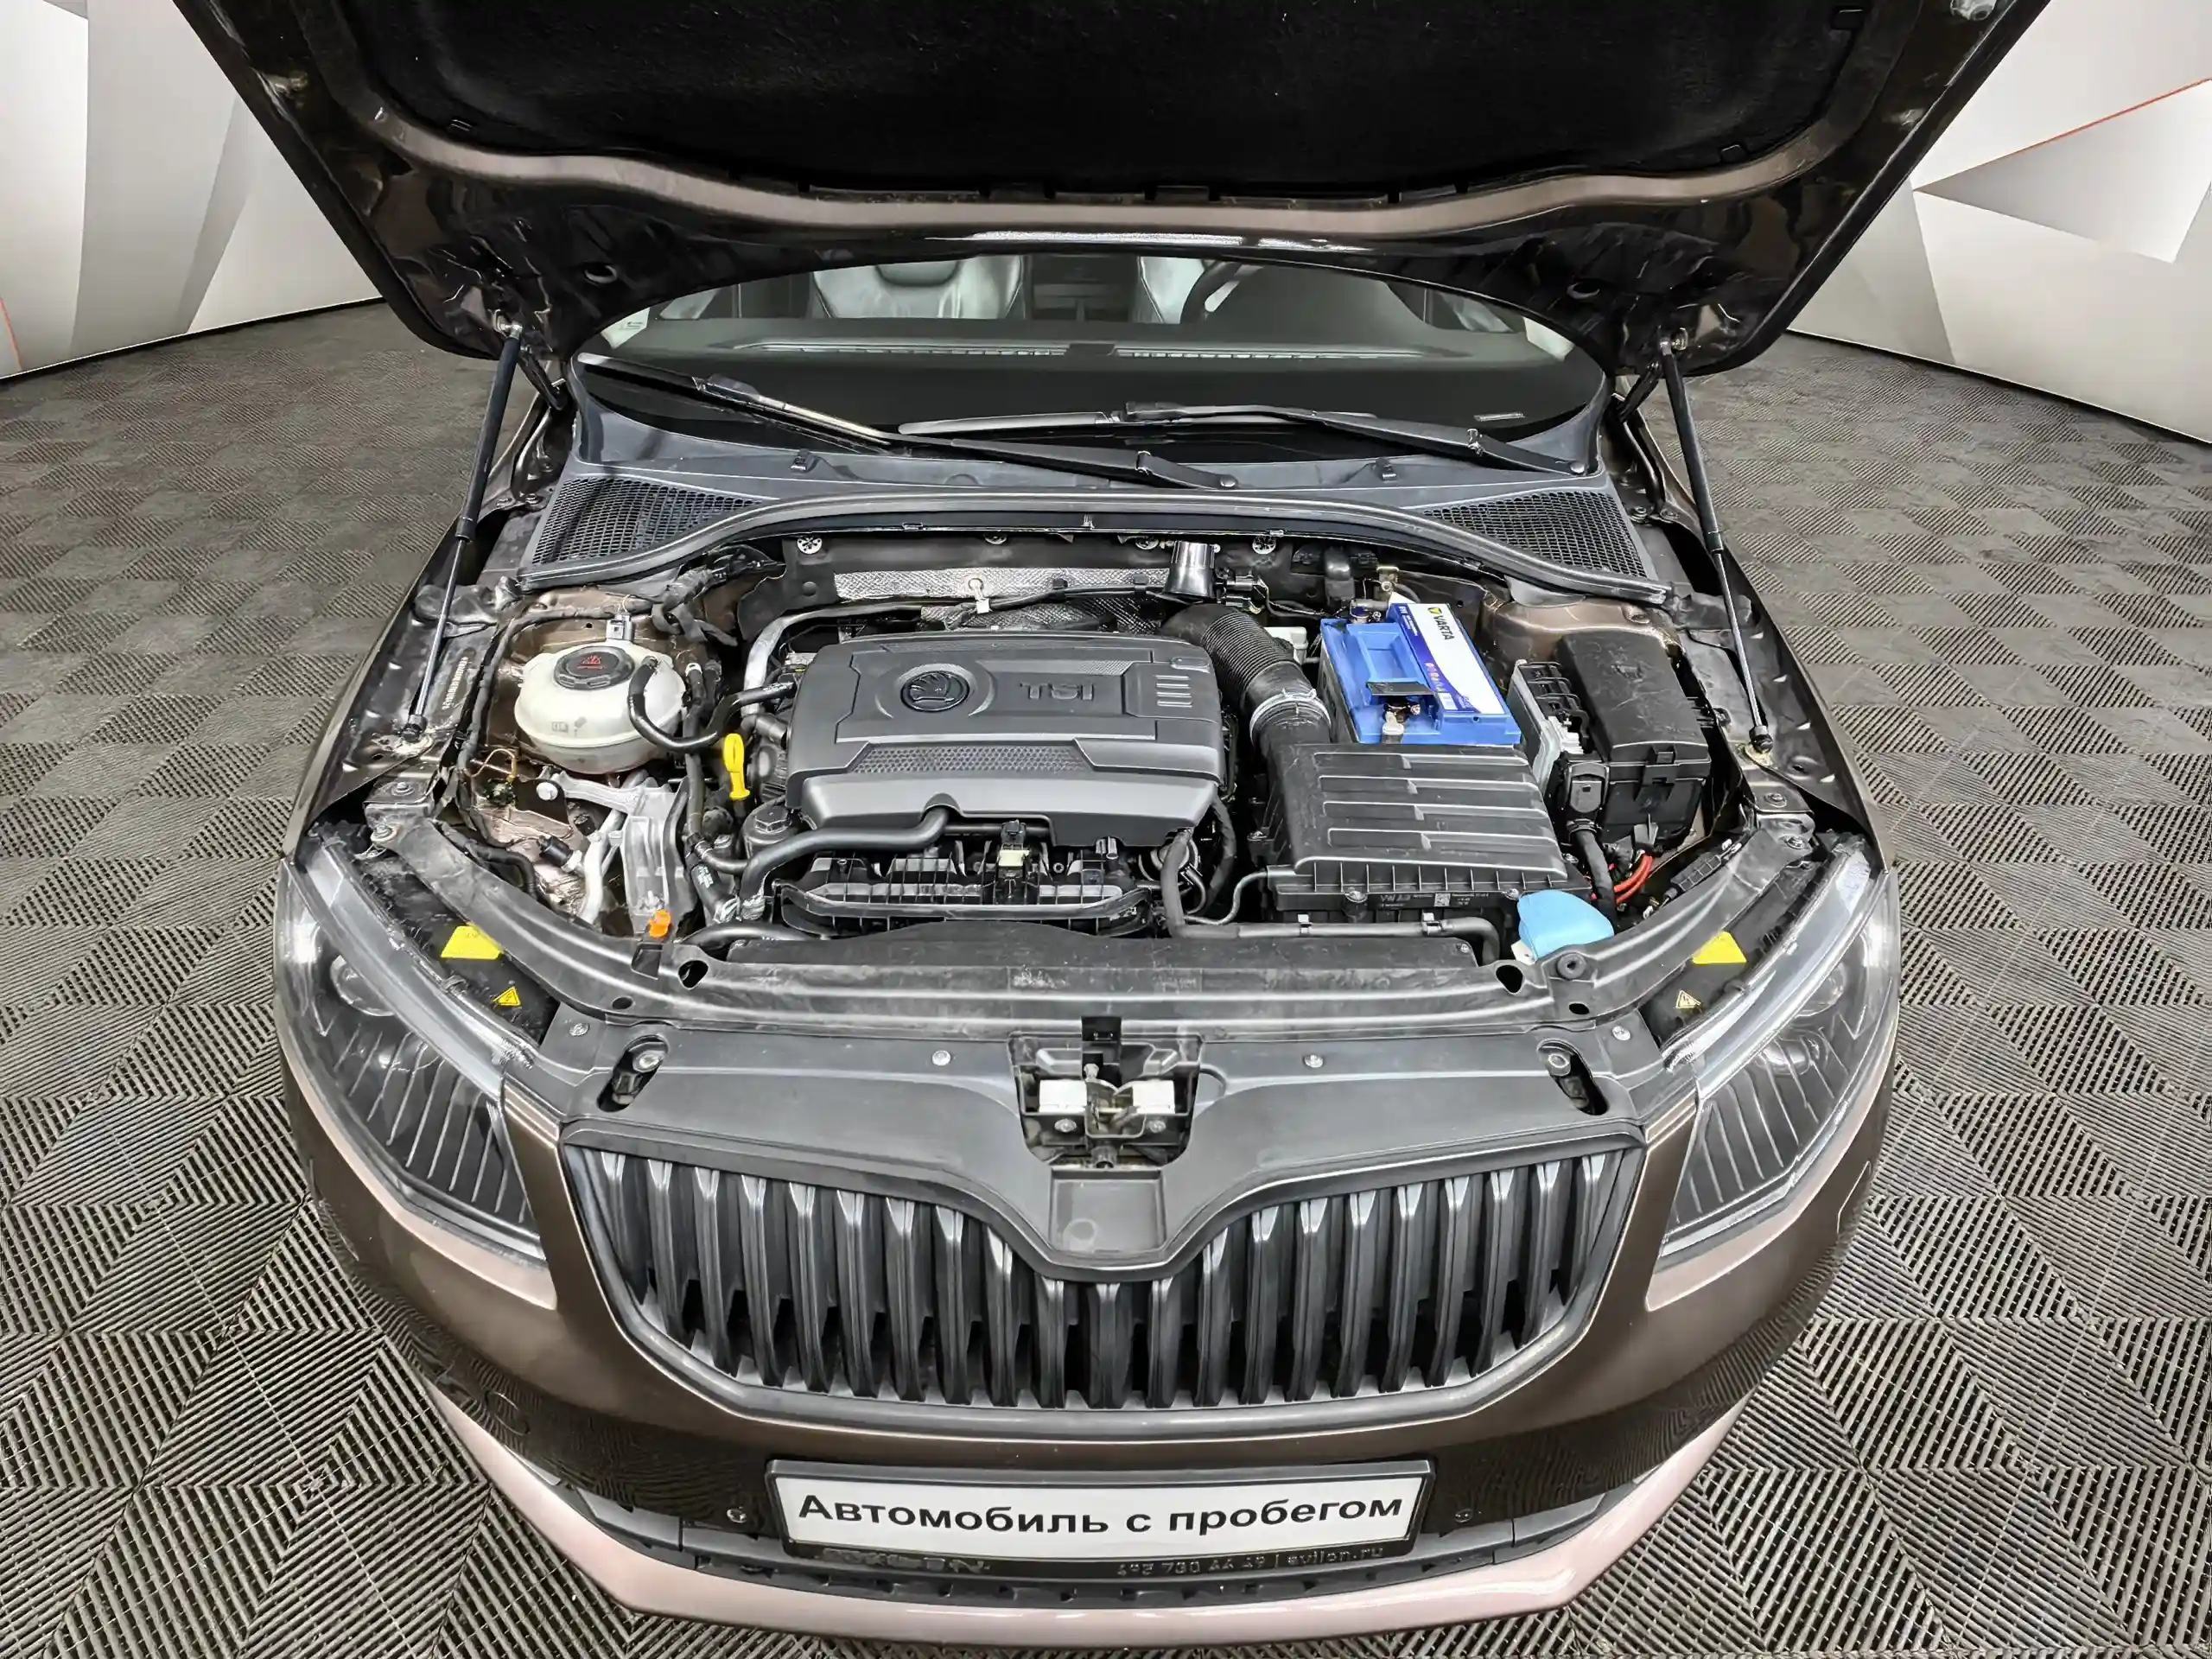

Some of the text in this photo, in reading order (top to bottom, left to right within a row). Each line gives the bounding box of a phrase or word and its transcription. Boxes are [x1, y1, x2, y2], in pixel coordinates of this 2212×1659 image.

[1433, 615, 1454, 640] VARTA
[1019, 681, 1095, 701] TSI
[798, 1494, 1403, 1535] Автомобиль с пробегом
